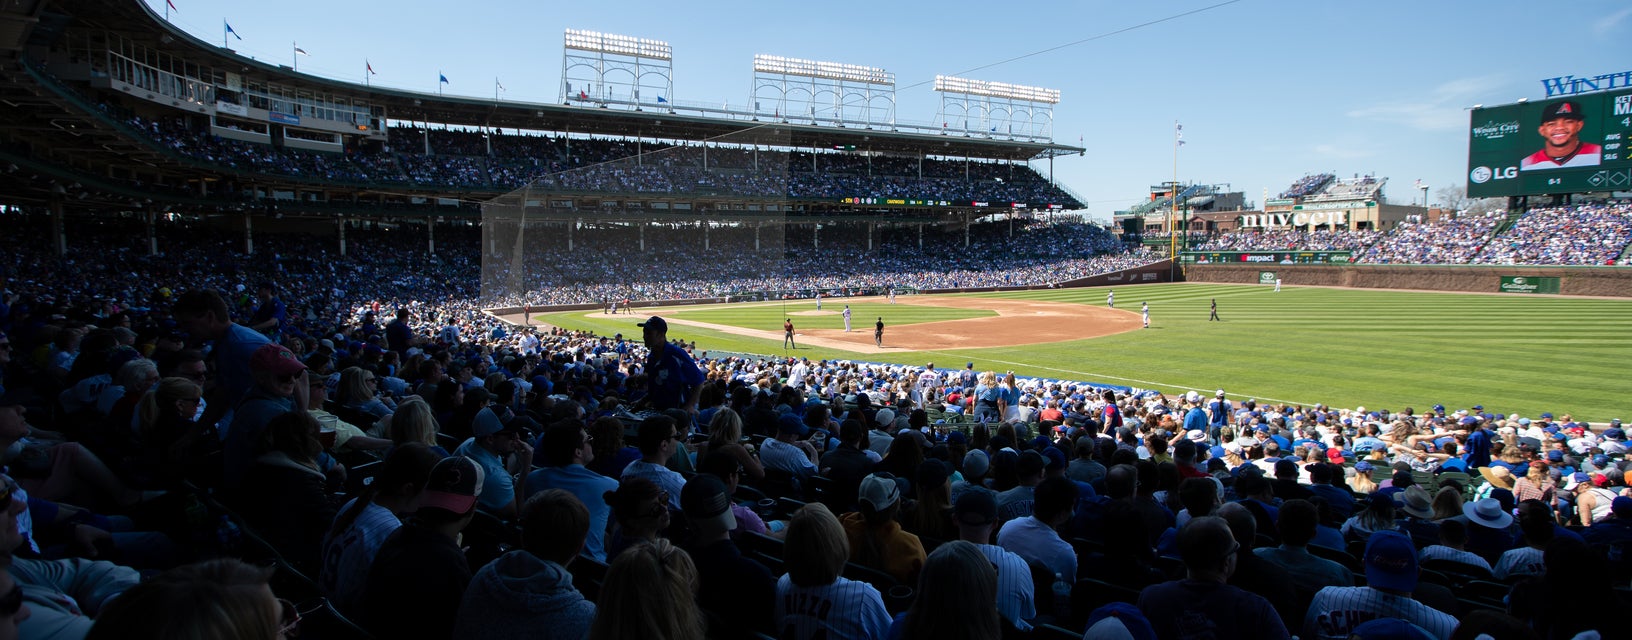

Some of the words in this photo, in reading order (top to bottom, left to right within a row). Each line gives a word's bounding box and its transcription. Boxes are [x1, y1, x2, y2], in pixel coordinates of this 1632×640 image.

[1493, 166, 1518, 180] LG
[1241, 210, 1347, 229] nuveen
[1246, 254, 1274, 263] impact
[785, 592, 832, 621] RIZZO
